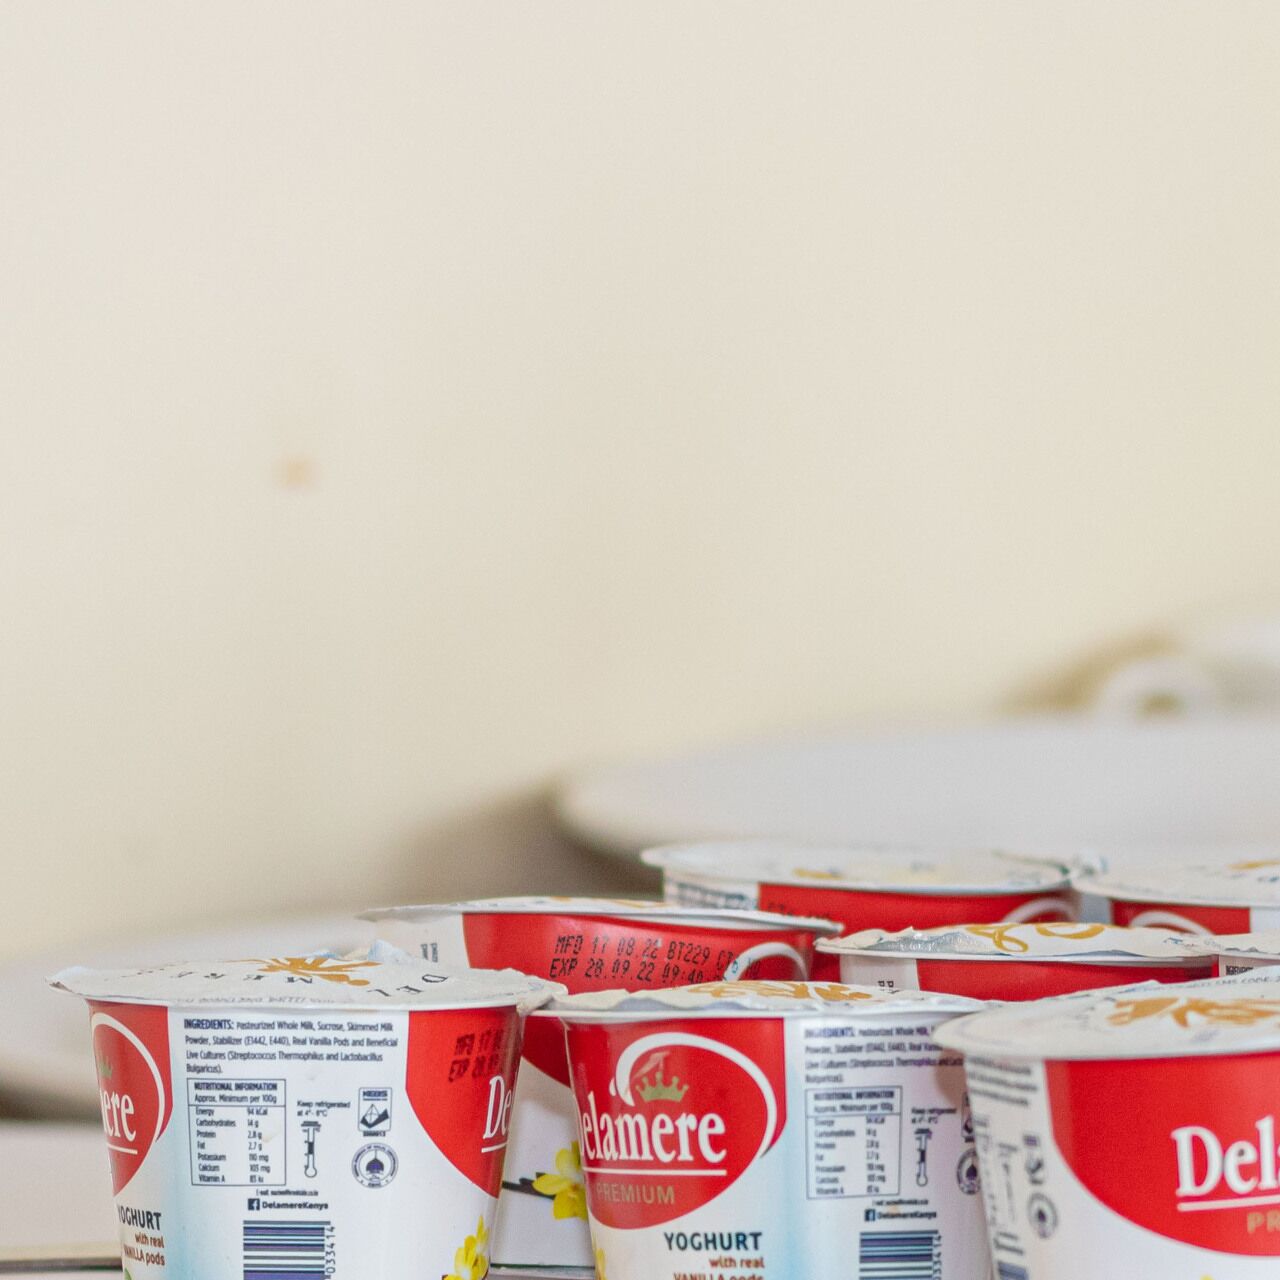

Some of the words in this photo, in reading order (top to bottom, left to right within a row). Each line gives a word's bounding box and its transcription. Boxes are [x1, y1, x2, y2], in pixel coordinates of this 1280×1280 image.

[554, 936, 583, 954] MFD
[592, 936, 609, 954] 17
[549, 958, 579, 978] EXP
[184, 1019, 234, 1031] INGREDIENTS:
[237, 1021, 275, 1031] Pasteurized
[277, 1021, 298, 1031] Whole
[347, 1021, 378, 1032] Skimmed
[380, 1022, 393, 1032] Milk
[185, 1036, 209, 1047] Powder,
[212, 1036, 242, 1046] Stabilizer
[292, 1037, 307, 1047] Real
[309, 1037, 332, 1047] Vanilla
[333, 1037, 349, 1047] Pods
[351, 1037, 365, 1047] and
[366, 1038, 398, 1048] Beneficial
[186, 1051, 197, 1060] Live
[199, 1051, 226, 1061] Cultures
[326, 1052, 339, 1061] and
[194, 1083, 232, 1091] NUTRITIONAL
[234, 1083, 277, 1091] INFORMATION
[219, 1094, 248, 1103] Minimum
[250, 1096, 260, 1104] per
[262, 1095, 277, 1104] 100g
[581, 1090, 727, 1164] elamere
[595, 1183, 675, 1205] PREMIUM
[262, 1200, 329, 1210] DelamereKenya
[134, 1233, 148, 1245] with
[148, 1234, 165, 1248] real
[664, 1232, 763, 1251] YOGHURT
[145, 1249, 166, 1266] pods
[709, 1256, 736, 1269] with
[739, 1256, 765, 1269] real
